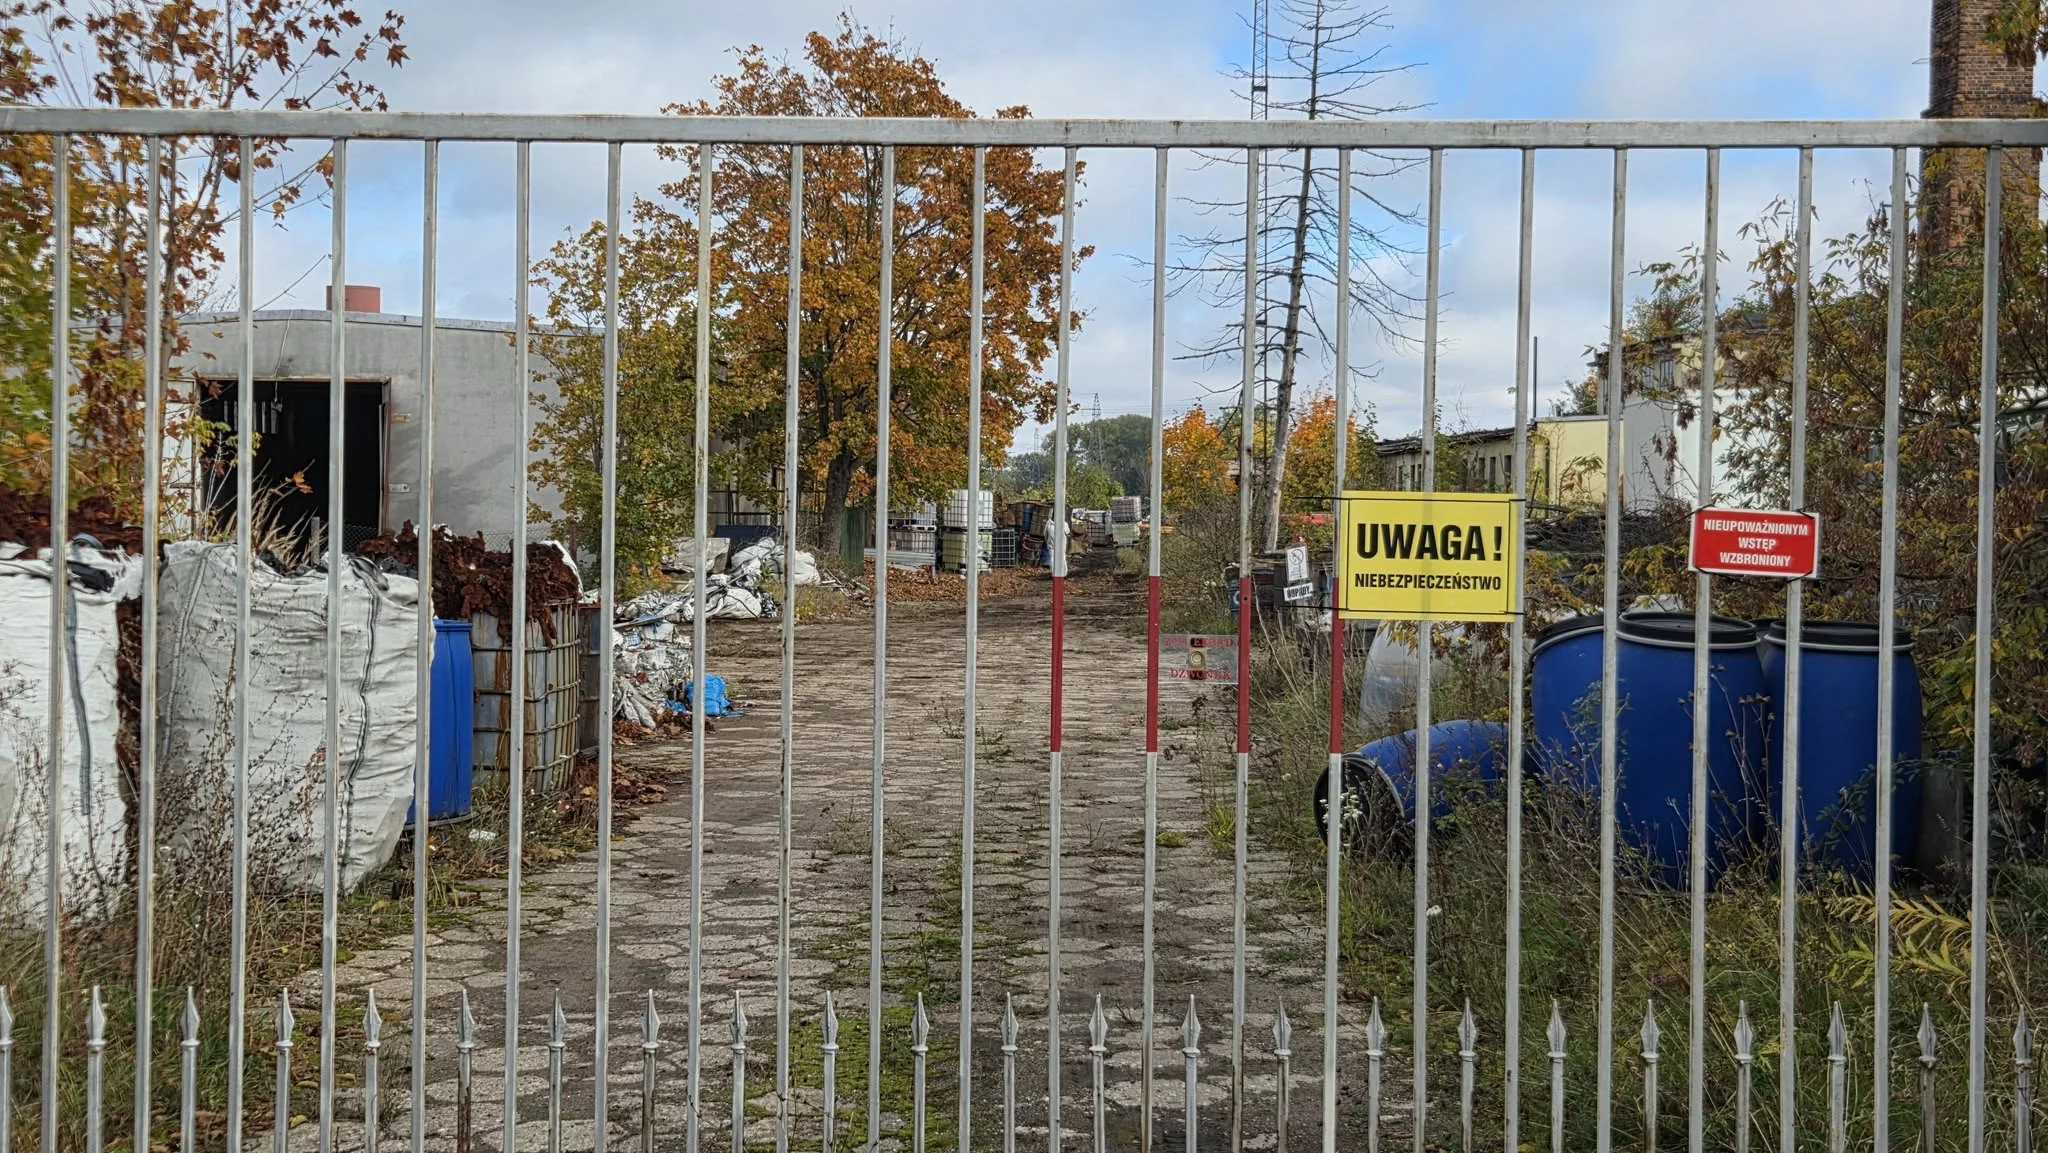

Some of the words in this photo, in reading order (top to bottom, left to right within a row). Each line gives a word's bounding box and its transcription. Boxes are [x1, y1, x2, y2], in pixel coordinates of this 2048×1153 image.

[1703, 519, 1809, 536] NIEUPOWAŻNIONYM
[1738, 537, 1777, 552] WSTĘP
[1720, 552, 1791, 567] WZBRONIONY
[1355, 572, 1500, 590] NIEBEZPIECZEŃSTWO
